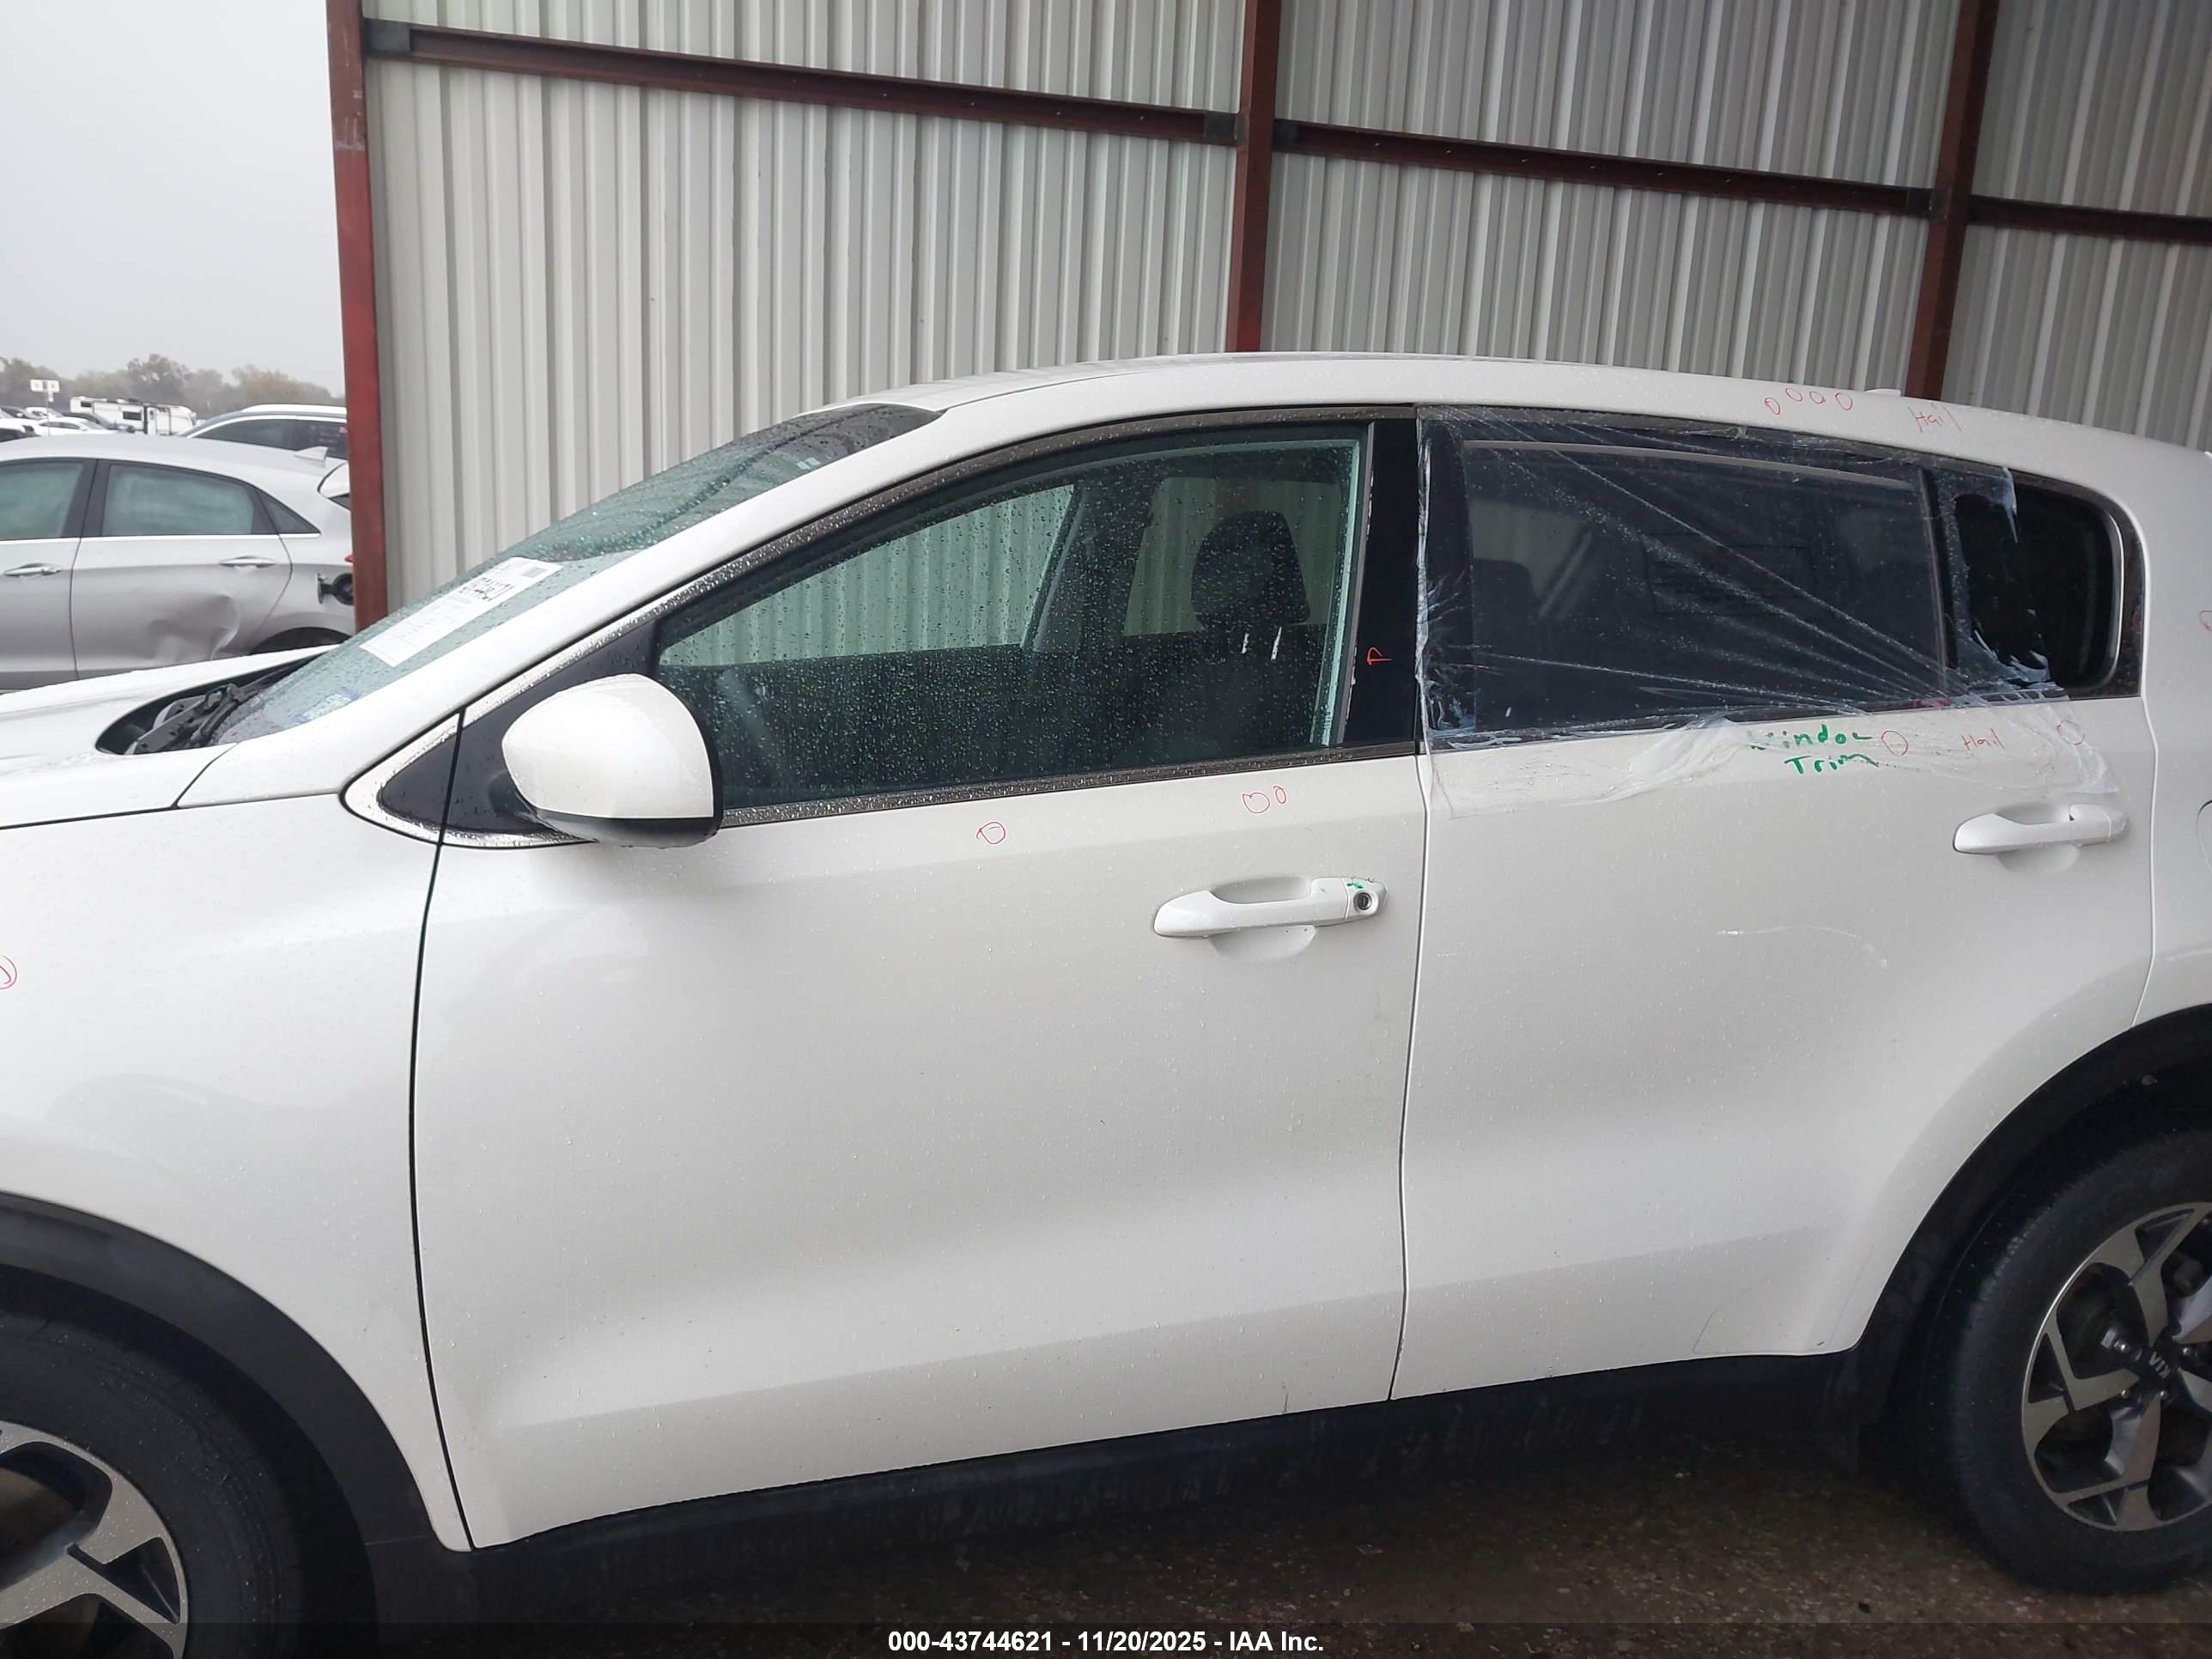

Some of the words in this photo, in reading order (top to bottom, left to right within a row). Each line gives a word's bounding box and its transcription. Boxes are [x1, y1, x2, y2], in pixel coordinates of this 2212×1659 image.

[1907, 402, 1963, 433] Hail
[1960, 727, 2006, 750] Hail
[2149, 1351, 2171, 1379] KIA
